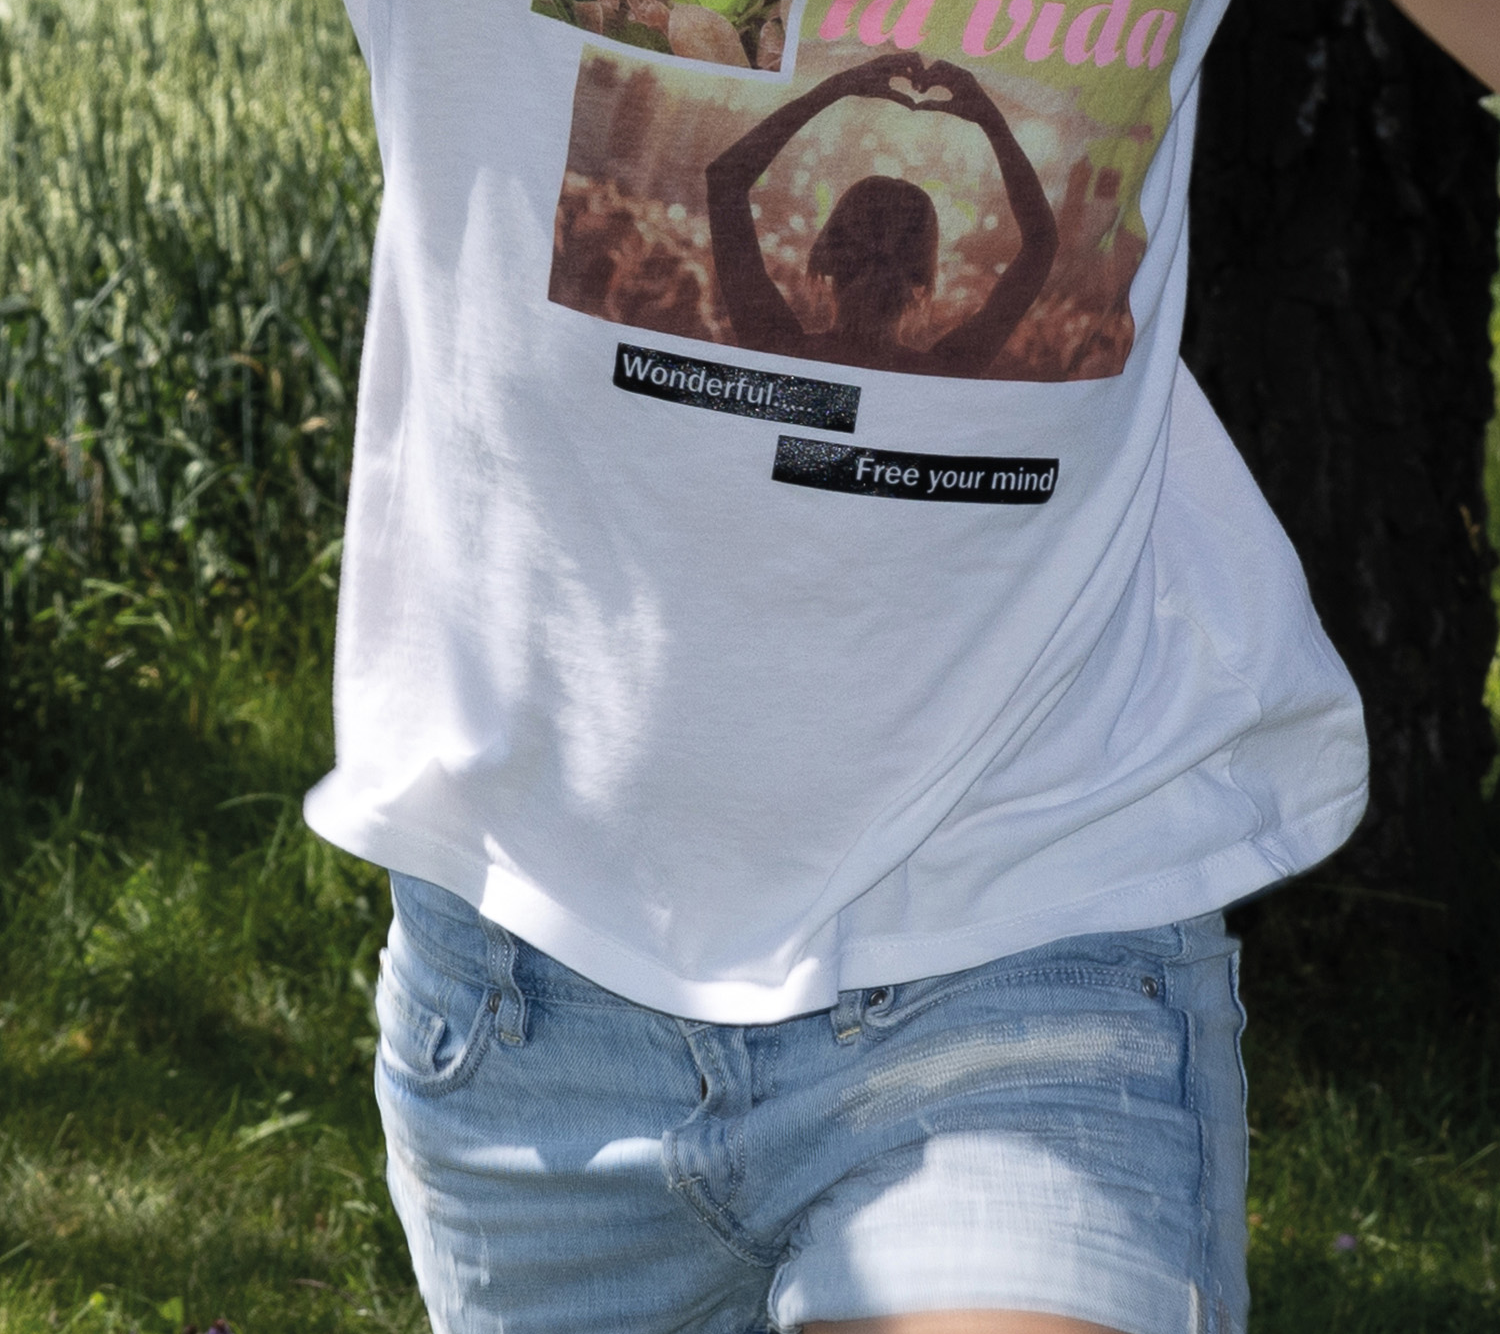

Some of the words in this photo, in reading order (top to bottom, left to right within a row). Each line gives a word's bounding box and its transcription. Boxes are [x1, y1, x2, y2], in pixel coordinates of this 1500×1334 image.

[855, 457, 920, 486] Free
[926, 469, 985, 493] your
[990, 466, 1054, 492] mind
